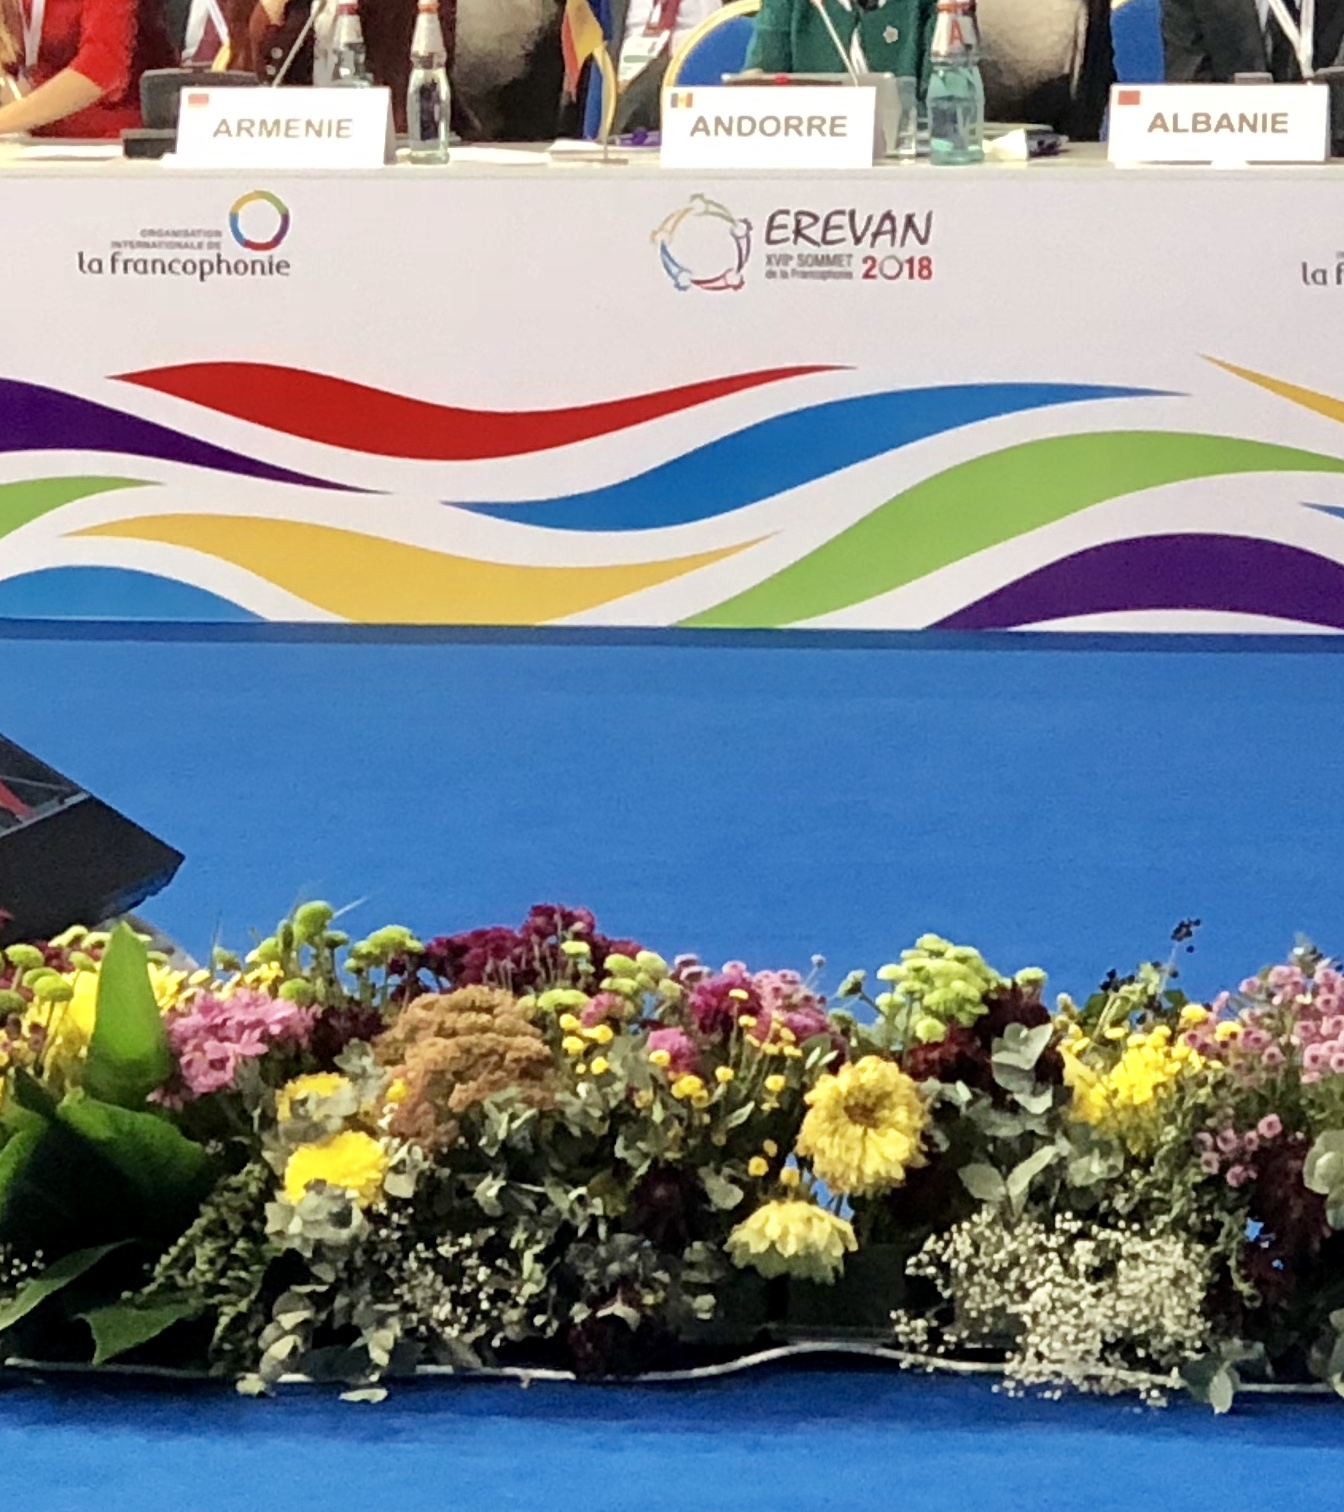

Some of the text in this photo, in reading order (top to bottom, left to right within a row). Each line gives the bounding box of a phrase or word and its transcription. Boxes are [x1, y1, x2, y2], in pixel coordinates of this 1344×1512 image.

[213, 118, 354, 138] ARMENIE
[690, 115, 848, 137] ANDORRE
[1147, 112, 1289, 133] ALBANIE
[139, 229, 222, 238] ORGANISATION
[765, 208, 933, 248] EREVAN
[78, 251, 291, 282] la francophonie
[796, 253, 853, 267] SOMMET
[862, 254, 933, 280] 2018
[1301, 261, 1327, 286] la
